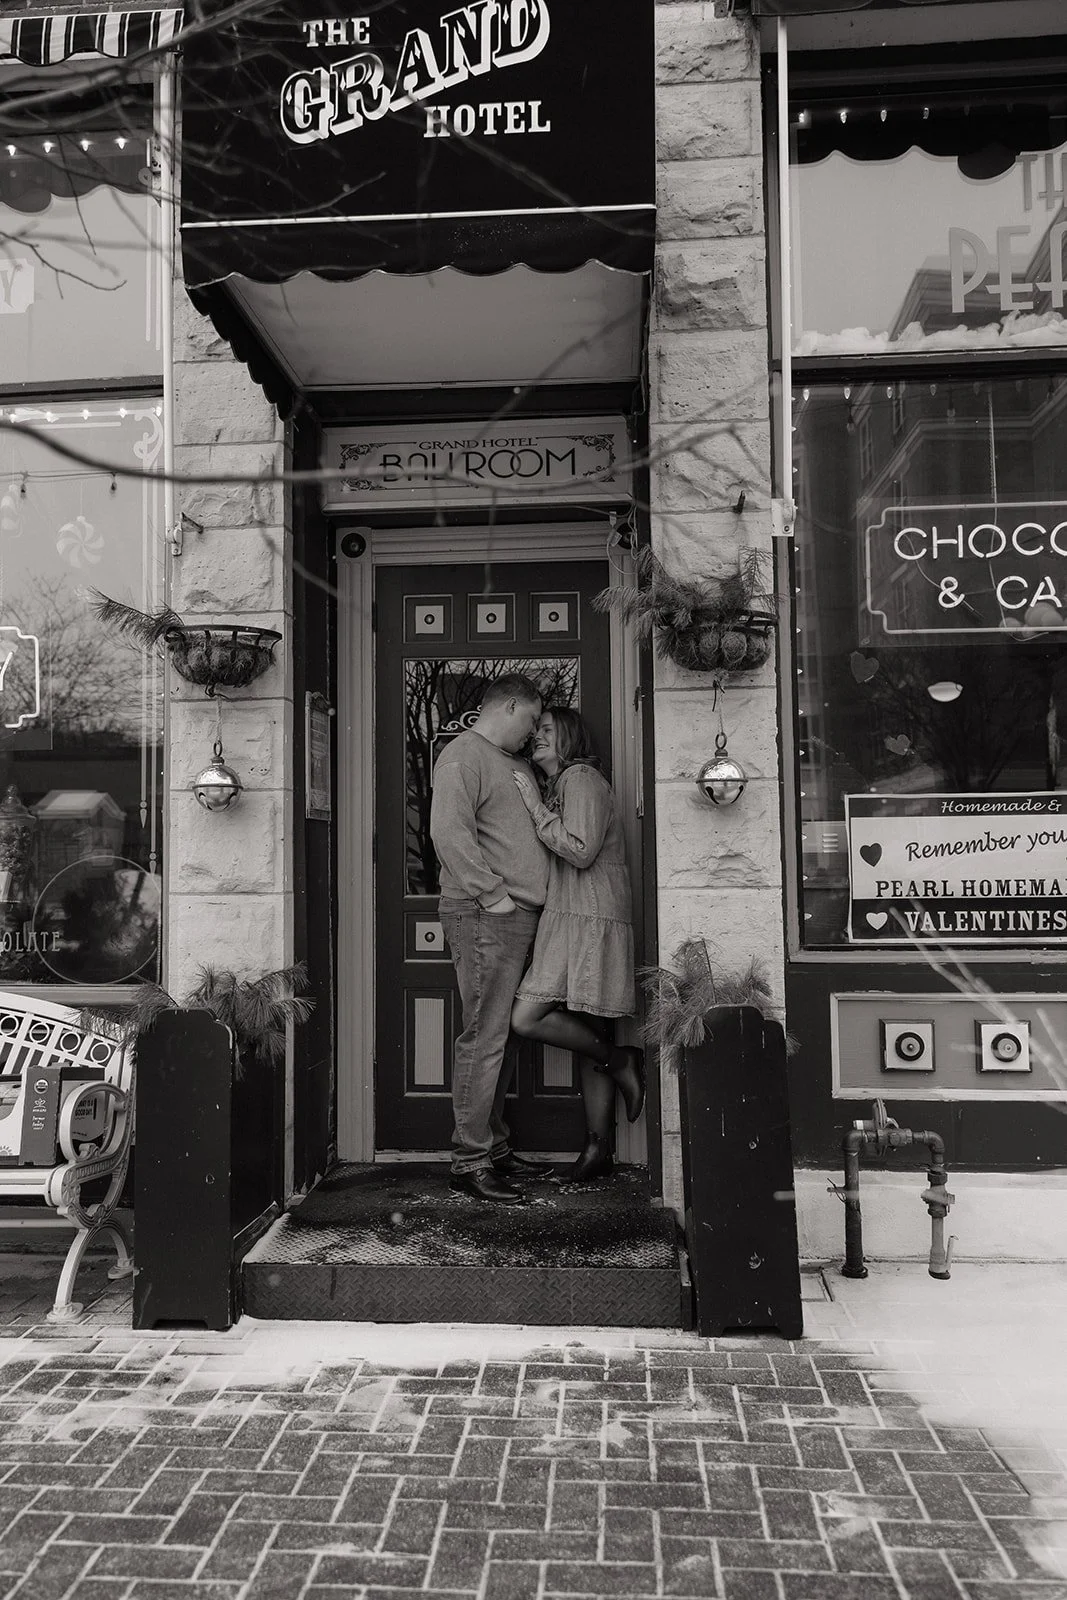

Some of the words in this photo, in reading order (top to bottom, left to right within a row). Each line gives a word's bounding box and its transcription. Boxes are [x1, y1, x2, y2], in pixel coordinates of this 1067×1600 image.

[303, 17, 370, 47] THE
[280, 0, 551, 144] GRAND
[423, 100, 551, 138] HOTEL
[418, 439, 479, 450] GRAND
[482, 437, 537, 448] HOTEL
[938, 576, 965, 608] &
[941, 798, 1046, 813] Homemade
[905, 831, 1022, 861] Remember
[876, 880, 955, 897] PEARL
[961, 878, 1067, 896] HOMEMA
